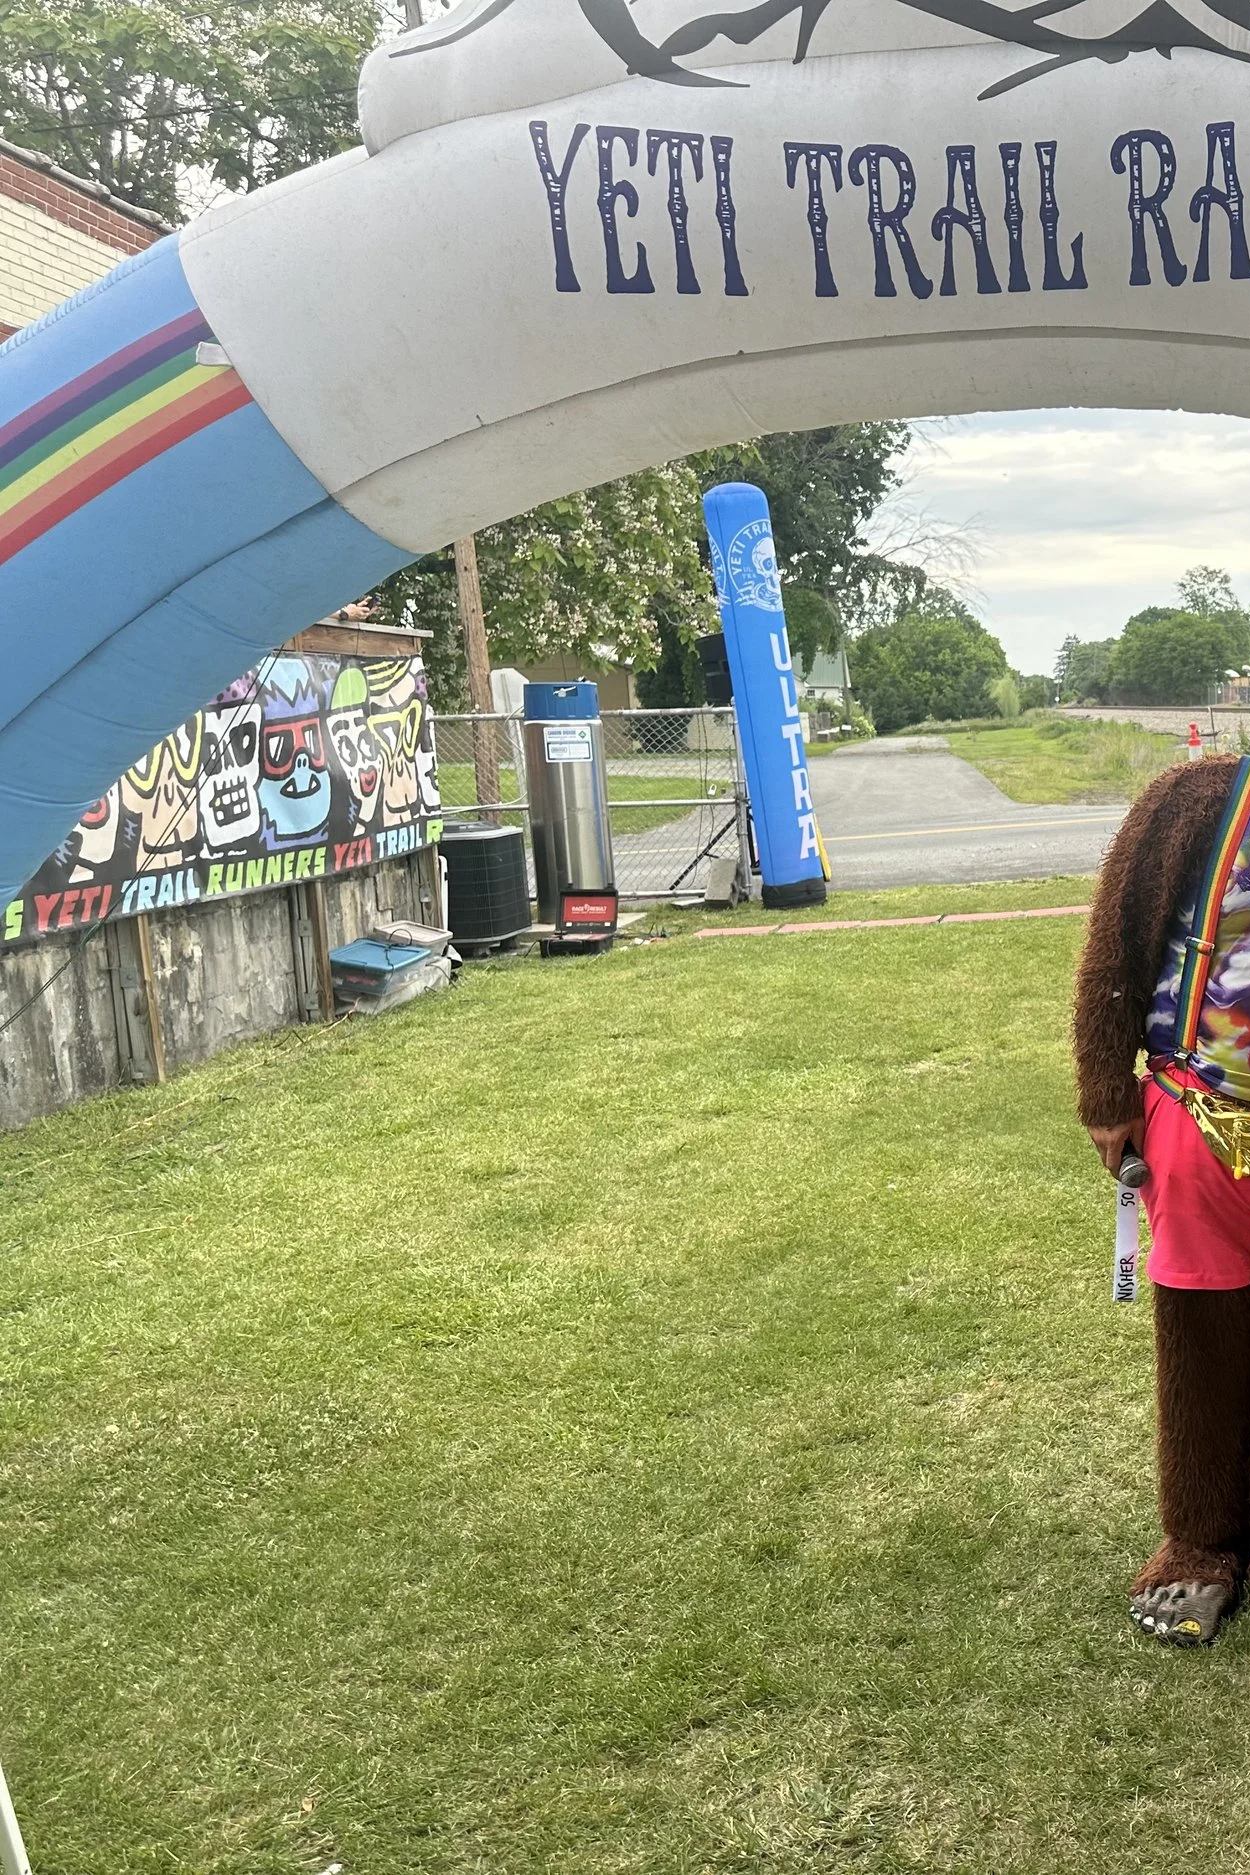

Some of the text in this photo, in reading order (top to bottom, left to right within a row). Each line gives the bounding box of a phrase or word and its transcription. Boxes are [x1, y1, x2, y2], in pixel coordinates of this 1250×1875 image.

[529, 120, 749, 297] YETI
[783, 139, 1089, 300] TRAIL
[731, 541, 746, 576] YETI
[770, 626, 820, 859] ULTRA
[34, 884, 112, 932] YETI
[121, 868, 200, 914] TRAIL
[206, 847, 327, 896] RUNNERS
[334, 837, 372, 871] YETI
[376, 823, 422, 859] TRAIL
[1121, 1192, 1136, 1207] 50
